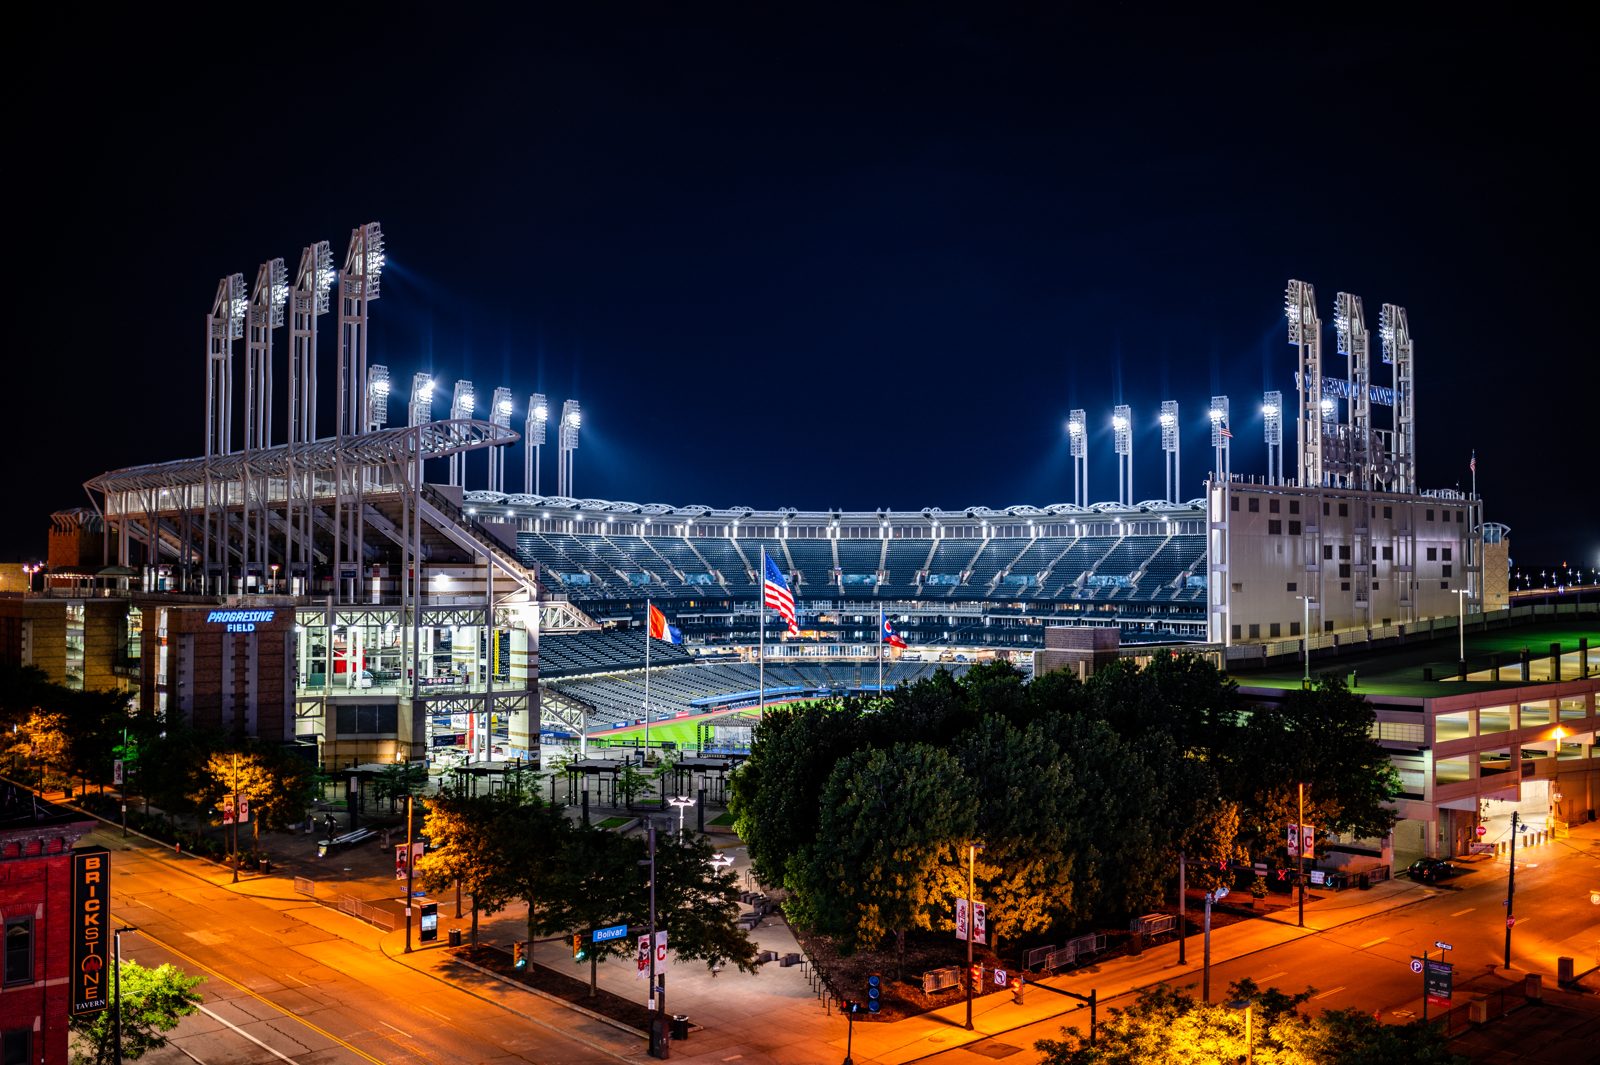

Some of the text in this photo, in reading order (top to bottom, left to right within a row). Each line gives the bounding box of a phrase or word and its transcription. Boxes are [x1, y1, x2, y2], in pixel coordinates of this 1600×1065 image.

[207, 611, 274, 622] PROGRESSIVE
[227, 623, 255, 632] FIELD
[240, 802, 247, 813] C
[1304, 836, 1313, 848] C
[597, 928, 623, 940] Bolivar
[657, 944, 666, 961] C
[1414, 962, 1420, 970] P
[75, 998, 106, 1010] TAVERN
